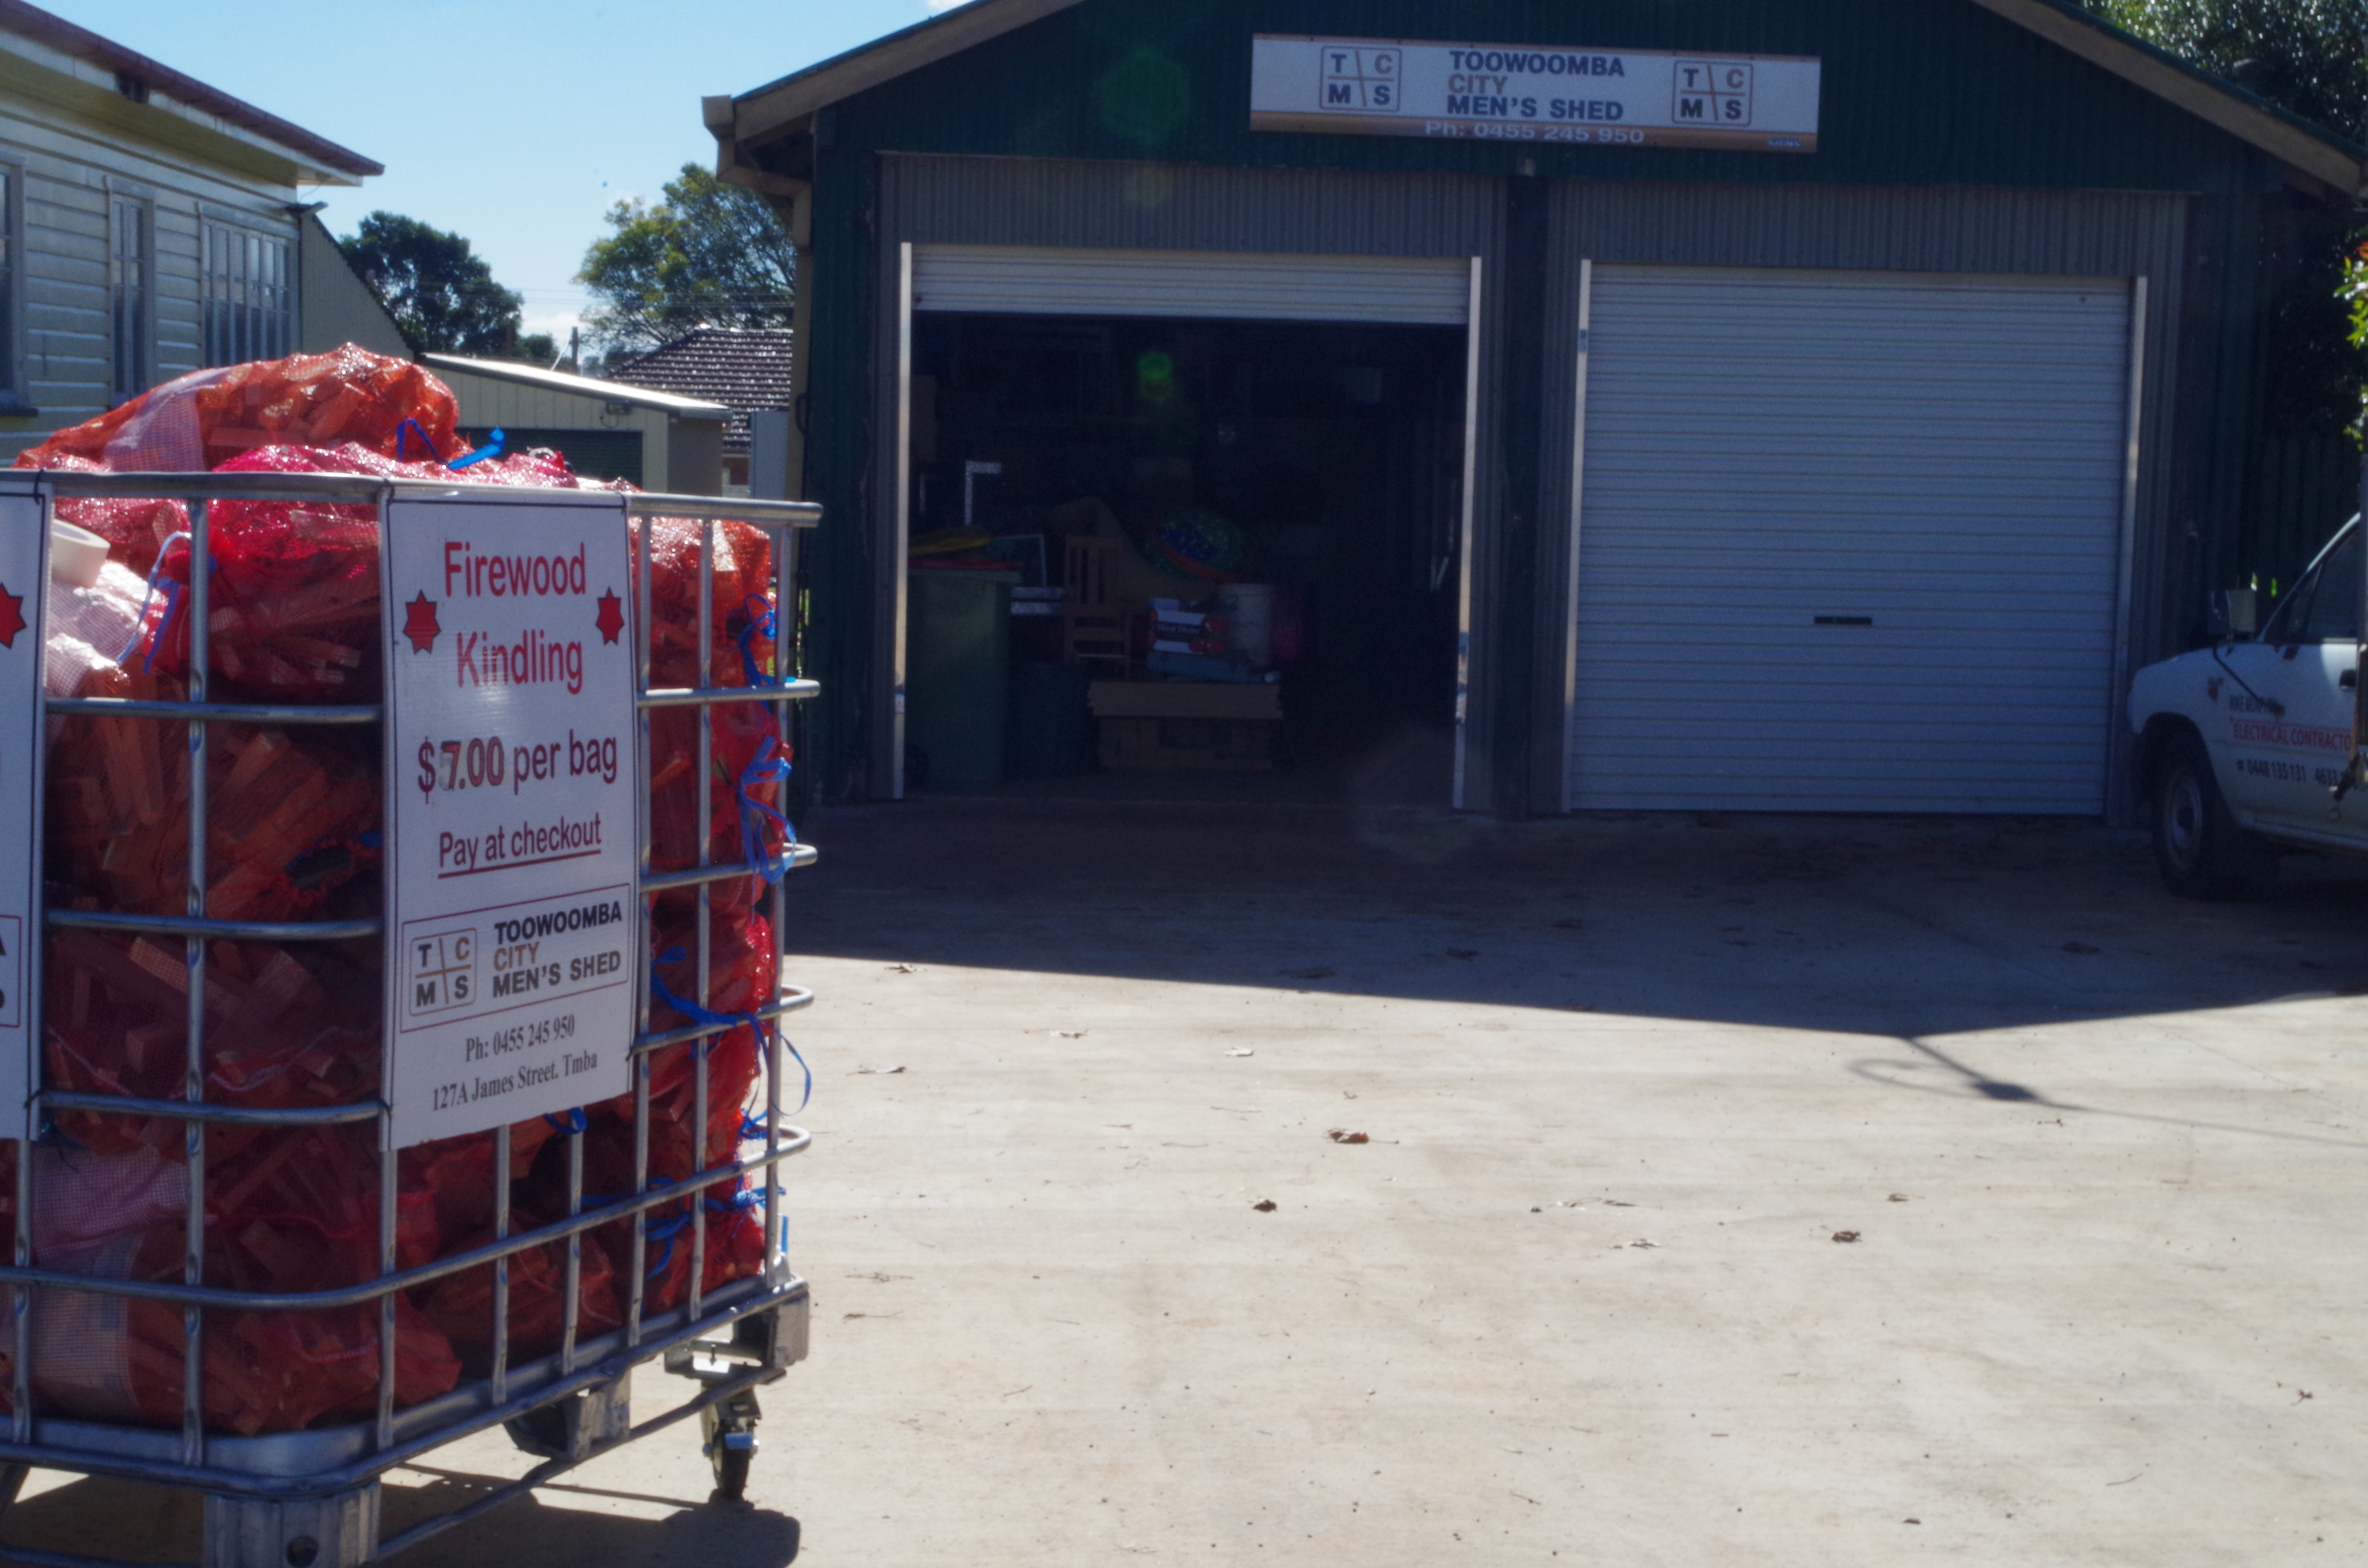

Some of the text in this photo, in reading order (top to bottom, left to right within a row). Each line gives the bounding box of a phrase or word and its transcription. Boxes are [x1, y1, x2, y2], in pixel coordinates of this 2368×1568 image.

[1331, 53, 1393, 74] T C
[1449, 50, 1625, 77] TOOWOOMBA
[1683, 68, 1744, 89] T C
[1328, 84, 1391, 105] M S
[1448, 74, 1508, 95] CITY
[1447, 95, 1624, 121] MEN'S SHED
[1681, 98, 1742, 120] M S
[1425, 120, 1645, 144] Ph: 0455 245 950
[444, 541, 586, 597] Firewood
[456, 628, 583, 695] Kindling
[2233, 723, 2289, 745] ELECTRICAL
[418, 728, 617, 804] $7.00 per bag
[439, 812, 602, 871] Pay at checkout
[494, 901, 622, 945] TOOWOOMBA
[418, 936, 470, 968] T C
[493, 942, 540, 971] CITY
[493, 950, 622, 998] MEN'S SHED
[416, 975, 469, 1007] M S
[465, 1014, 575, 1063] Ph: 0455 245 950
[432, 1080, 469, 1111] 127A
[471, 1073, 514, 1102] James
